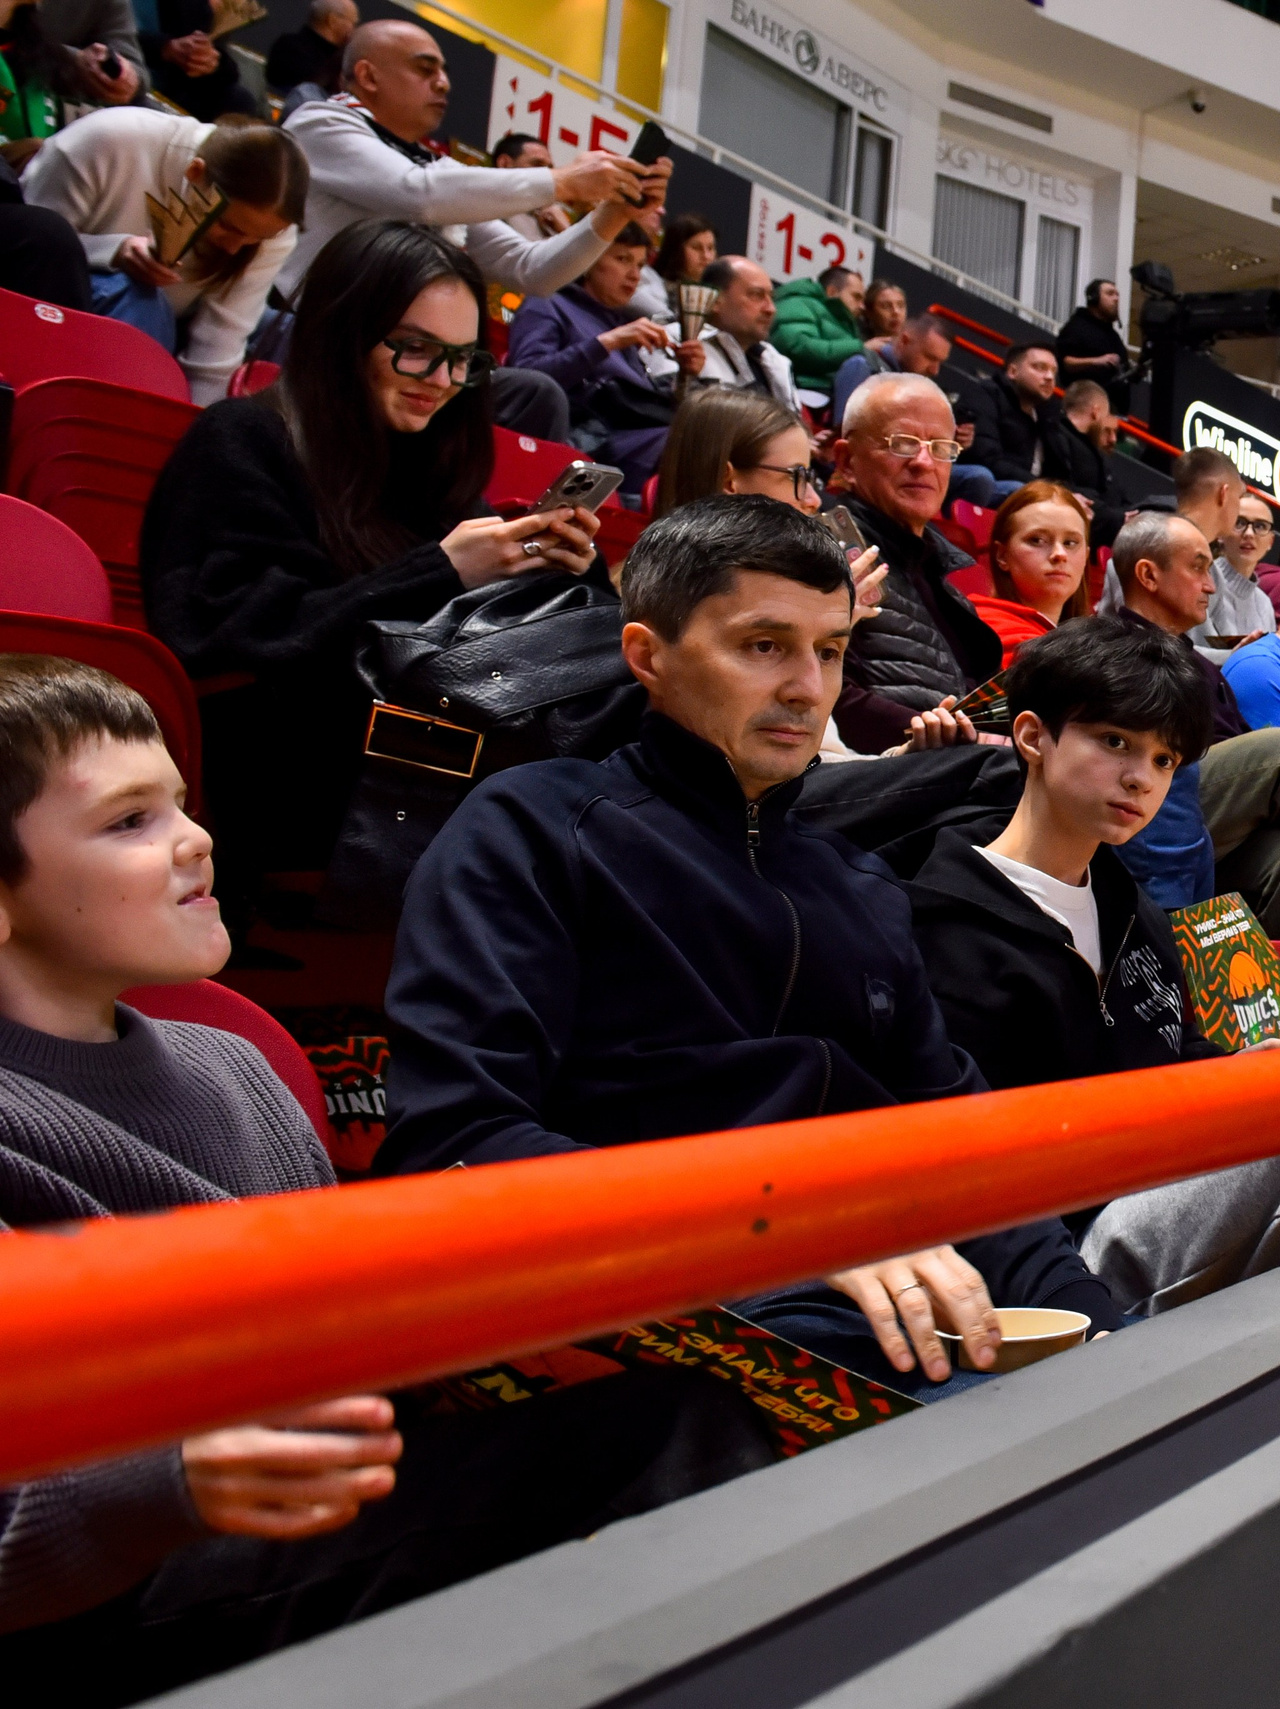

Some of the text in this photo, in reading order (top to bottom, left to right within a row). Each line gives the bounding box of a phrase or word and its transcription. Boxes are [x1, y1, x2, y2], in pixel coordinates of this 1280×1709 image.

[731, 0, 889, 113] БАНК АВЕРС
[985, 155, 1078, 207] HOTELS
[1195, 418, 1273, 487] Winline
[1200, 934, 1215, 948] МЫ
[1233, 988, 1280, 1034] UNICS
[683, 1331, 786, 1390] ЗНАЙ,
[794, 1385, 860, 1421] ЧТО
